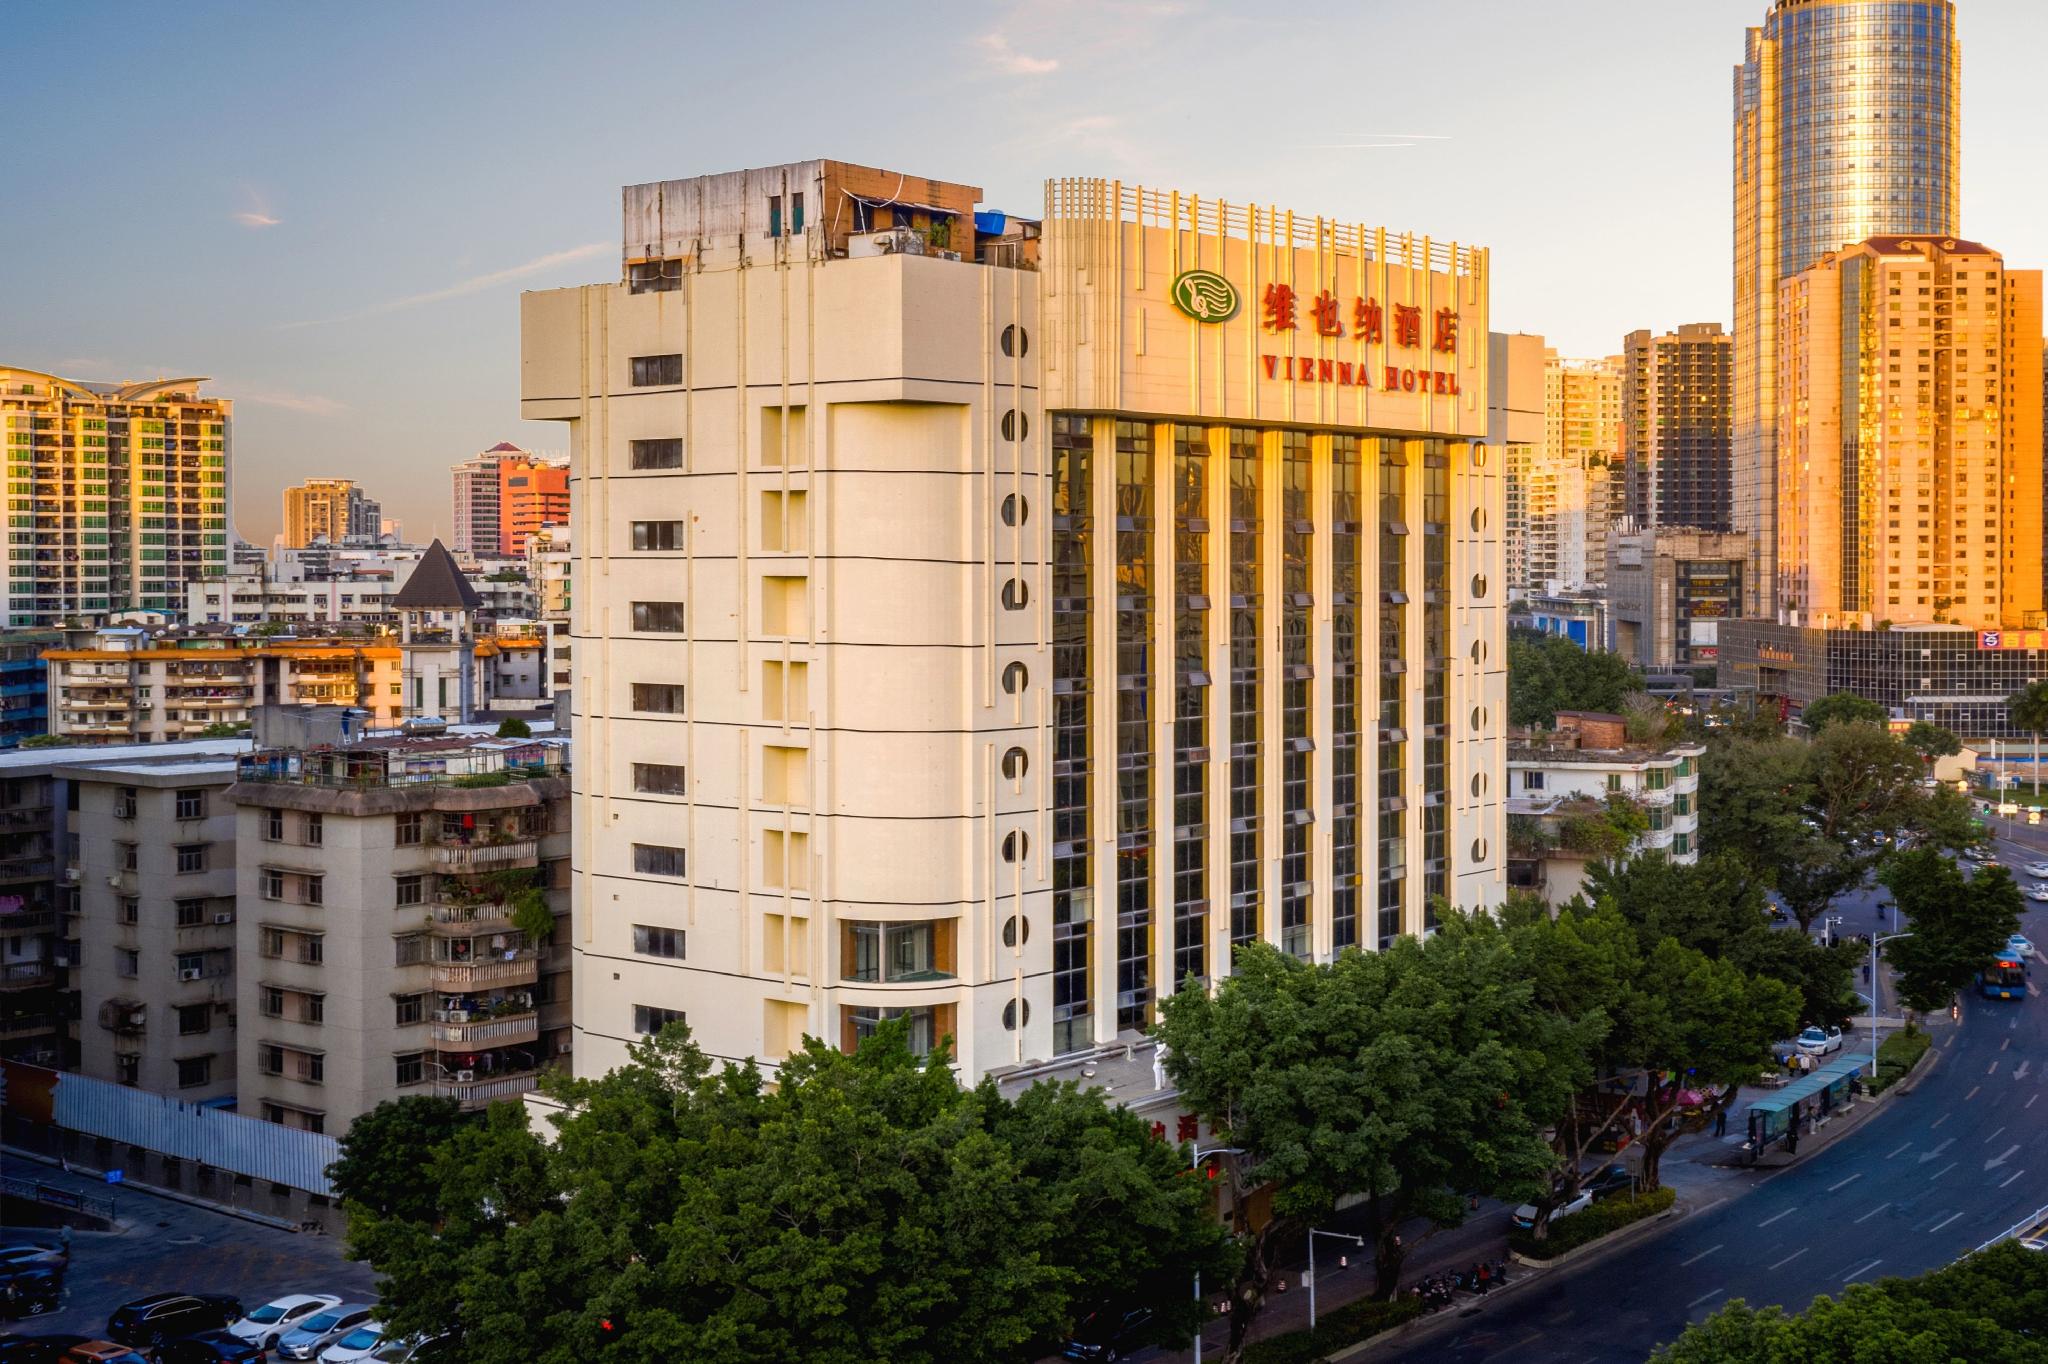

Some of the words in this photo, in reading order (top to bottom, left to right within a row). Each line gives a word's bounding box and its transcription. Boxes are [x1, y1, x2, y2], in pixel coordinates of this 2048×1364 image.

[1263, 283, 1460, 354] 维也纳酒店
[1262, 354, 1370, 386] VIENNA
[1385, 366, 1460, 396] HOTEL
